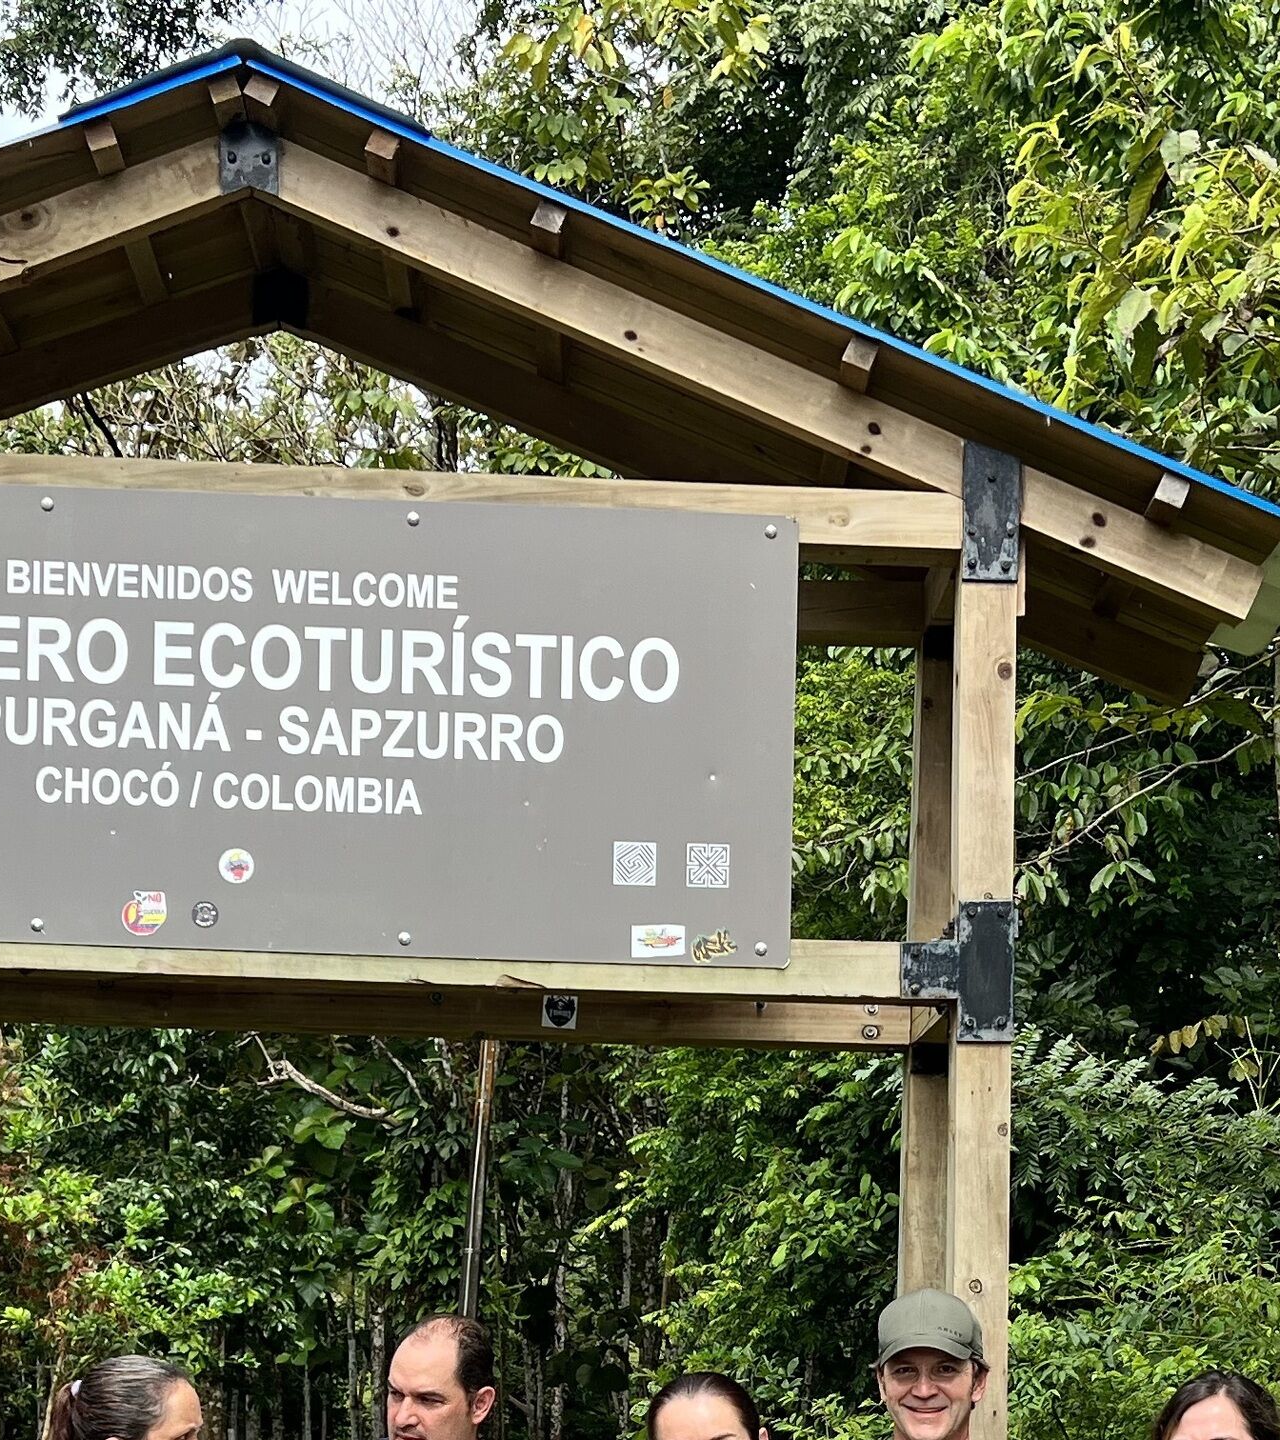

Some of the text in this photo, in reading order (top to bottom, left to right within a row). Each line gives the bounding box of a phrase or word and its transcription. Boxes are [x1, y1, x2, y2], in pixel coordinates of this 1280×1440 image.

[6, 559, 459, 610] BIENVENIDOS WELCOME
[153, 615, 680, 704] ECOTURÍSTICO
[246, 729, 263, 741] -
[277, 705, 565, 764] SAPZURRO
[35, 761, 423, 816] CHOCÓ / COLOMBIA
